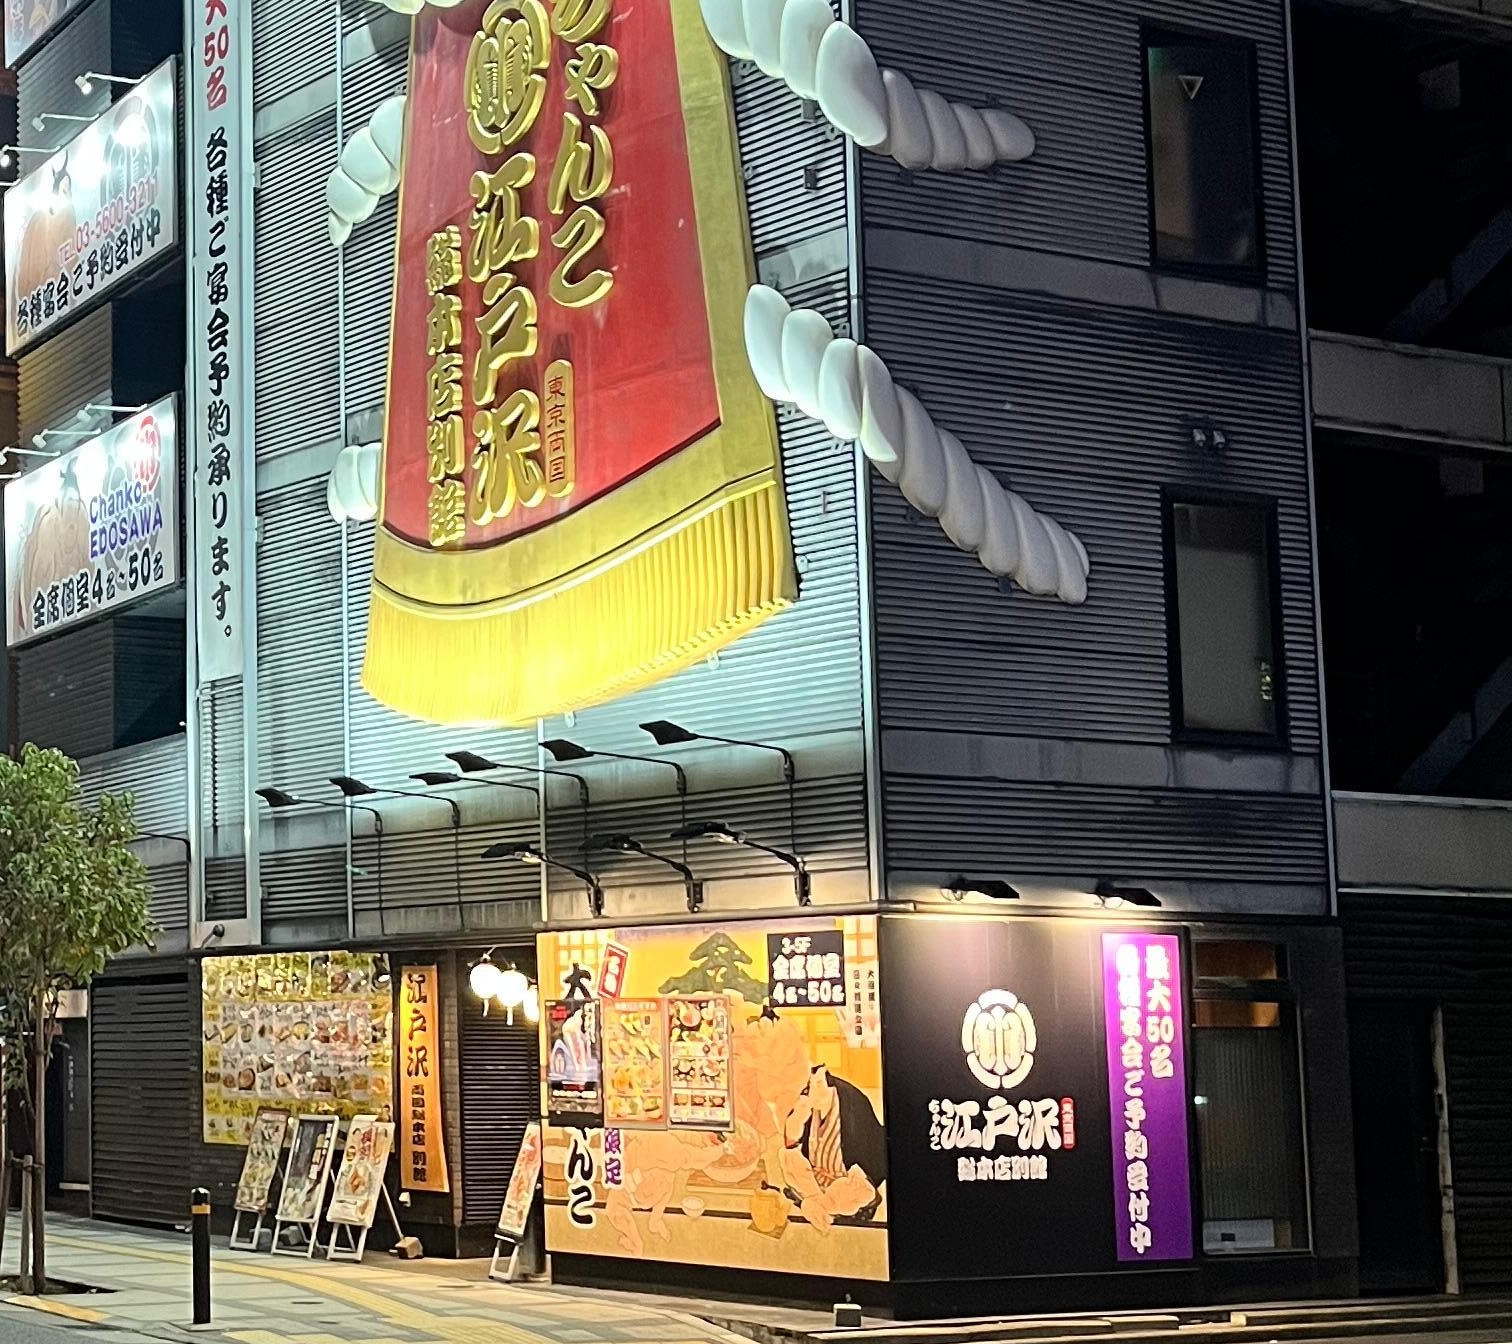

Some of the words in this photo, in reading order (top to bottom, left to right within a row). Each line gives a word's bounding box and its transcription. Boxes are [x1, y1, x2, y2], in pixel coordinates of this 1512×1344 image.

[467, 150, 548, 527] 江戸沢
[546, 375, 566, 484] 東京両国
[90, 506, 164, 559] EDOSAWA
[406, 972, 429, 1078] 江戸沢
[940, 1095, 1062, 1152] 江戸沢
